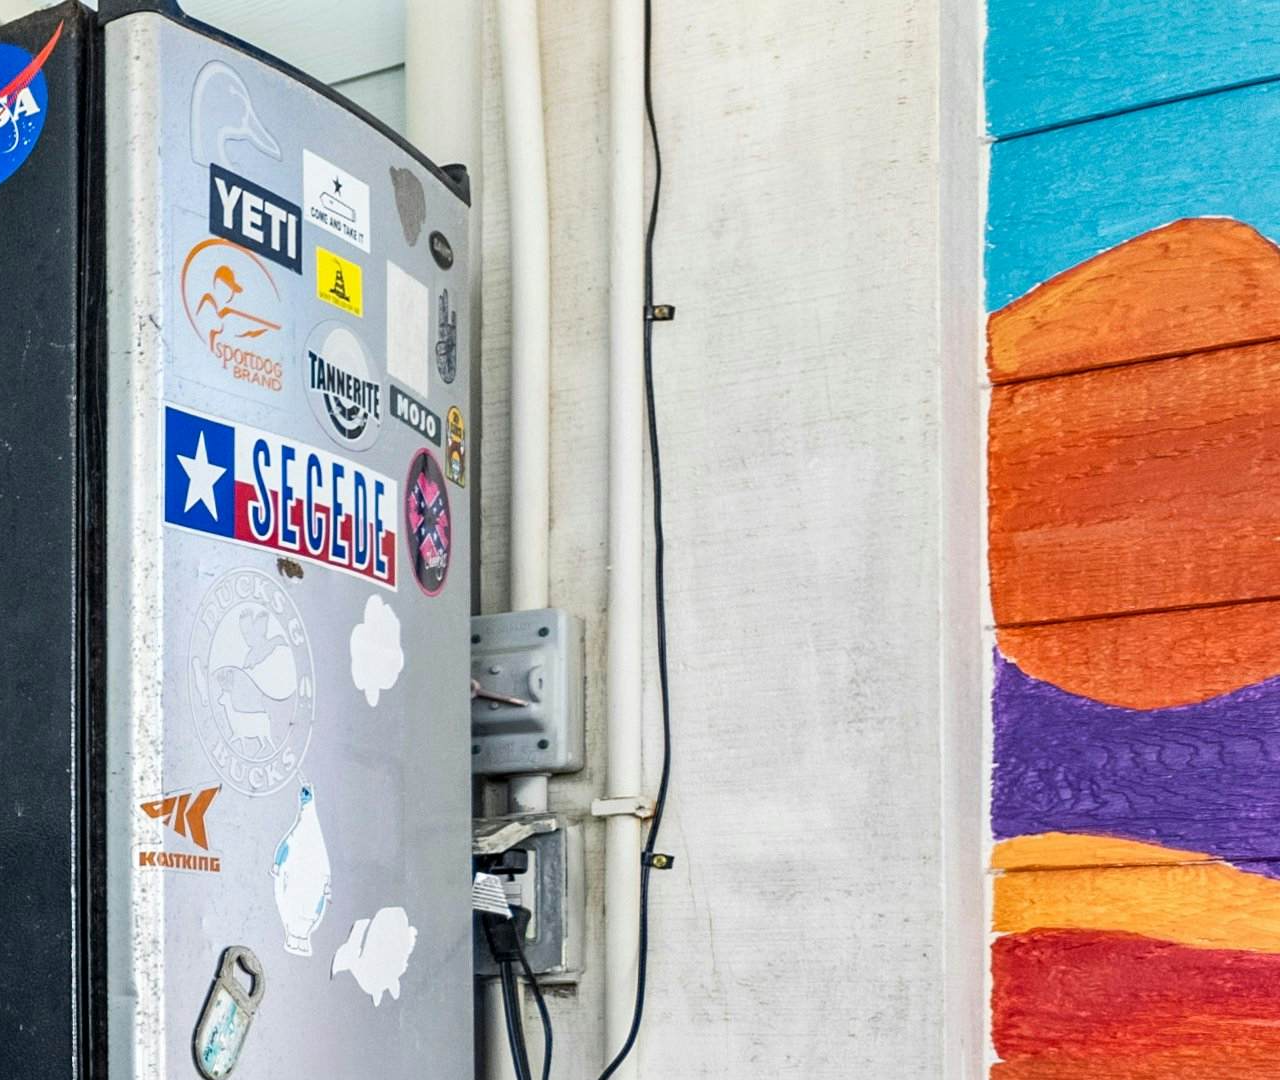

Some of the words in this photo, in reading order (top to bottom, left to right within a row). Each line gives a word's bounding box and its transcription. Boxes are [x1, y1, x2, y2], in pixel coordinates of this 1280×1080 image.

[214, 176, 297, 260] YETI
[311, 206, 328, 224] COME
[329, 217, 342, 231] AND
[343, 223, 357, 241] TAKE
[233, 366, 282, 391] BRAND
[308, 350, 380, 420] TANNERITE
[397, 393, 437, 439] MOJO
[250, 437, 388, 577] SECEDE
[200, 575, 287, 635] DUCKS
